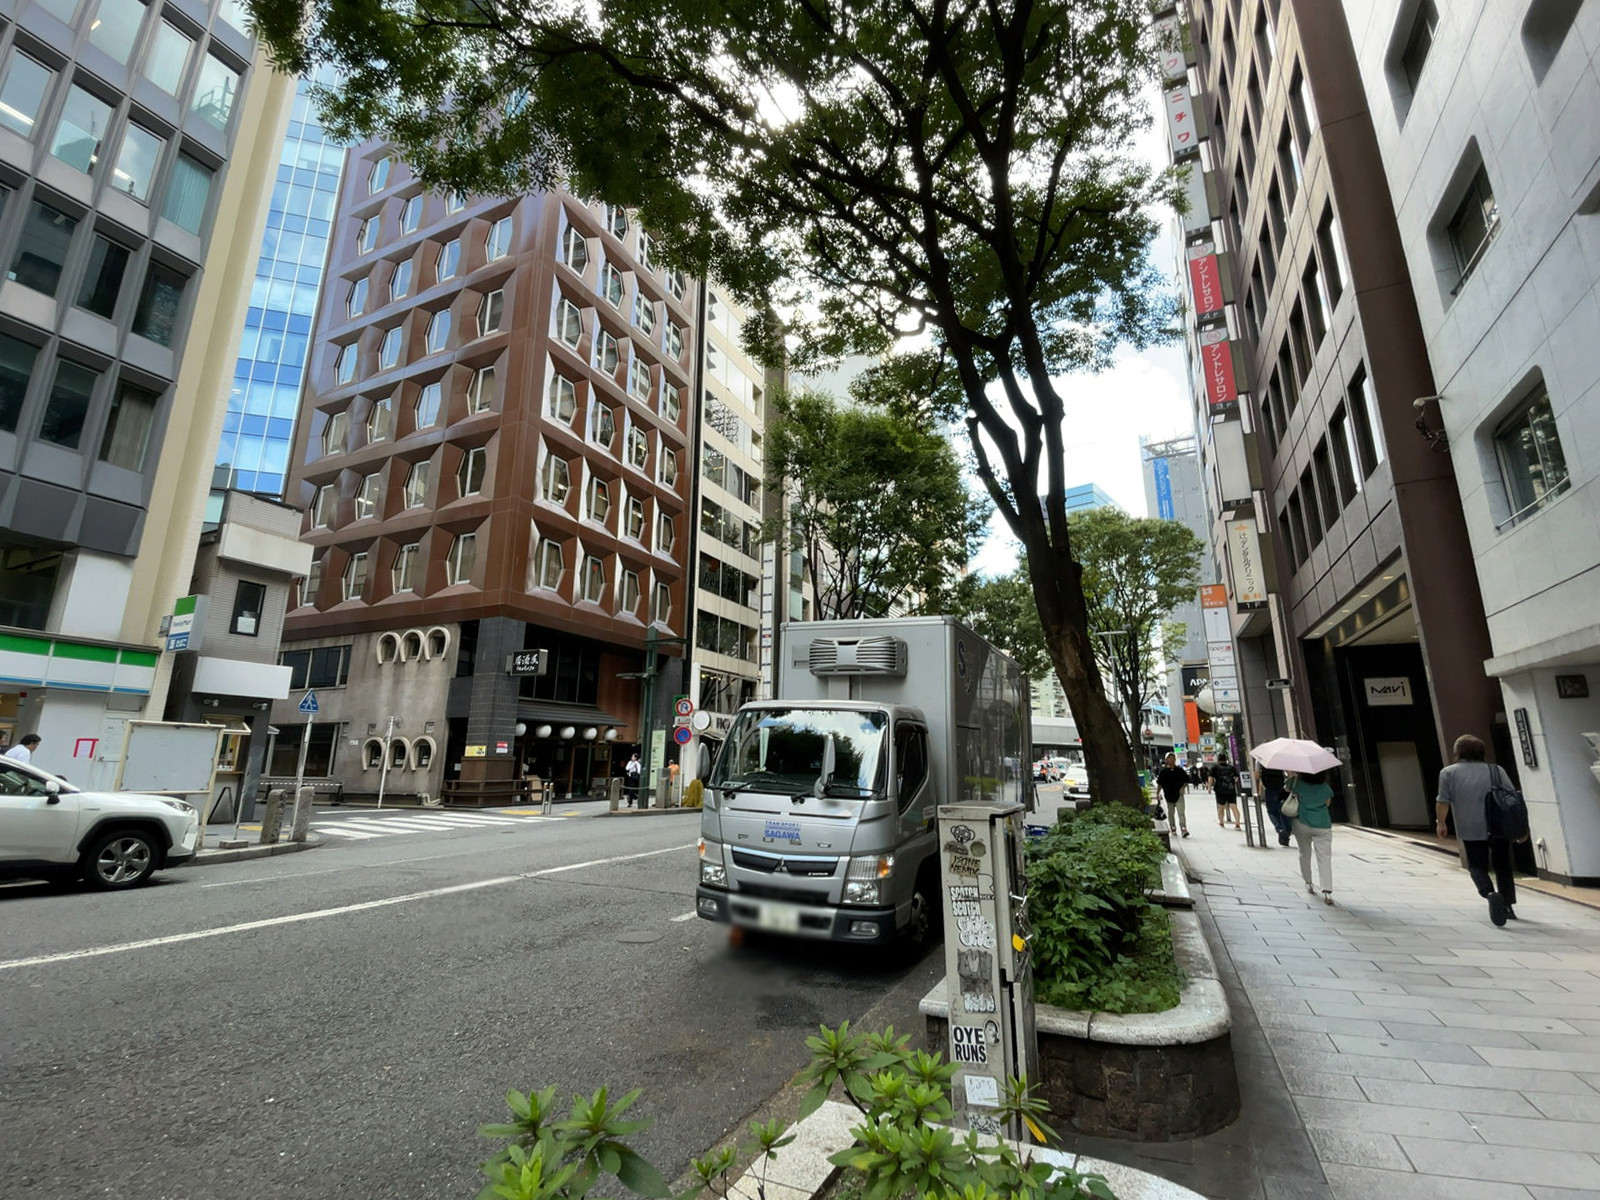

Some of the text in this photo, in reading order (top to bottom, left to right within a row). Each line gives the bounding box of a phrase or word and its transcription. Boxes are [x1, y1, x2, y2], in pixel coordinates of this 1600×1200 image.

[1172, 93, 1190, 143] ニチワ
[1198, 258, 1214, 312] アントレサロン
[1210, 344, 1227, 402] アントレサロン
[764, 830, 801, 840] SAGAWA
[953, 1026, 985, 1045] OYE
[955, 1043, 987, 1063] RUNS
